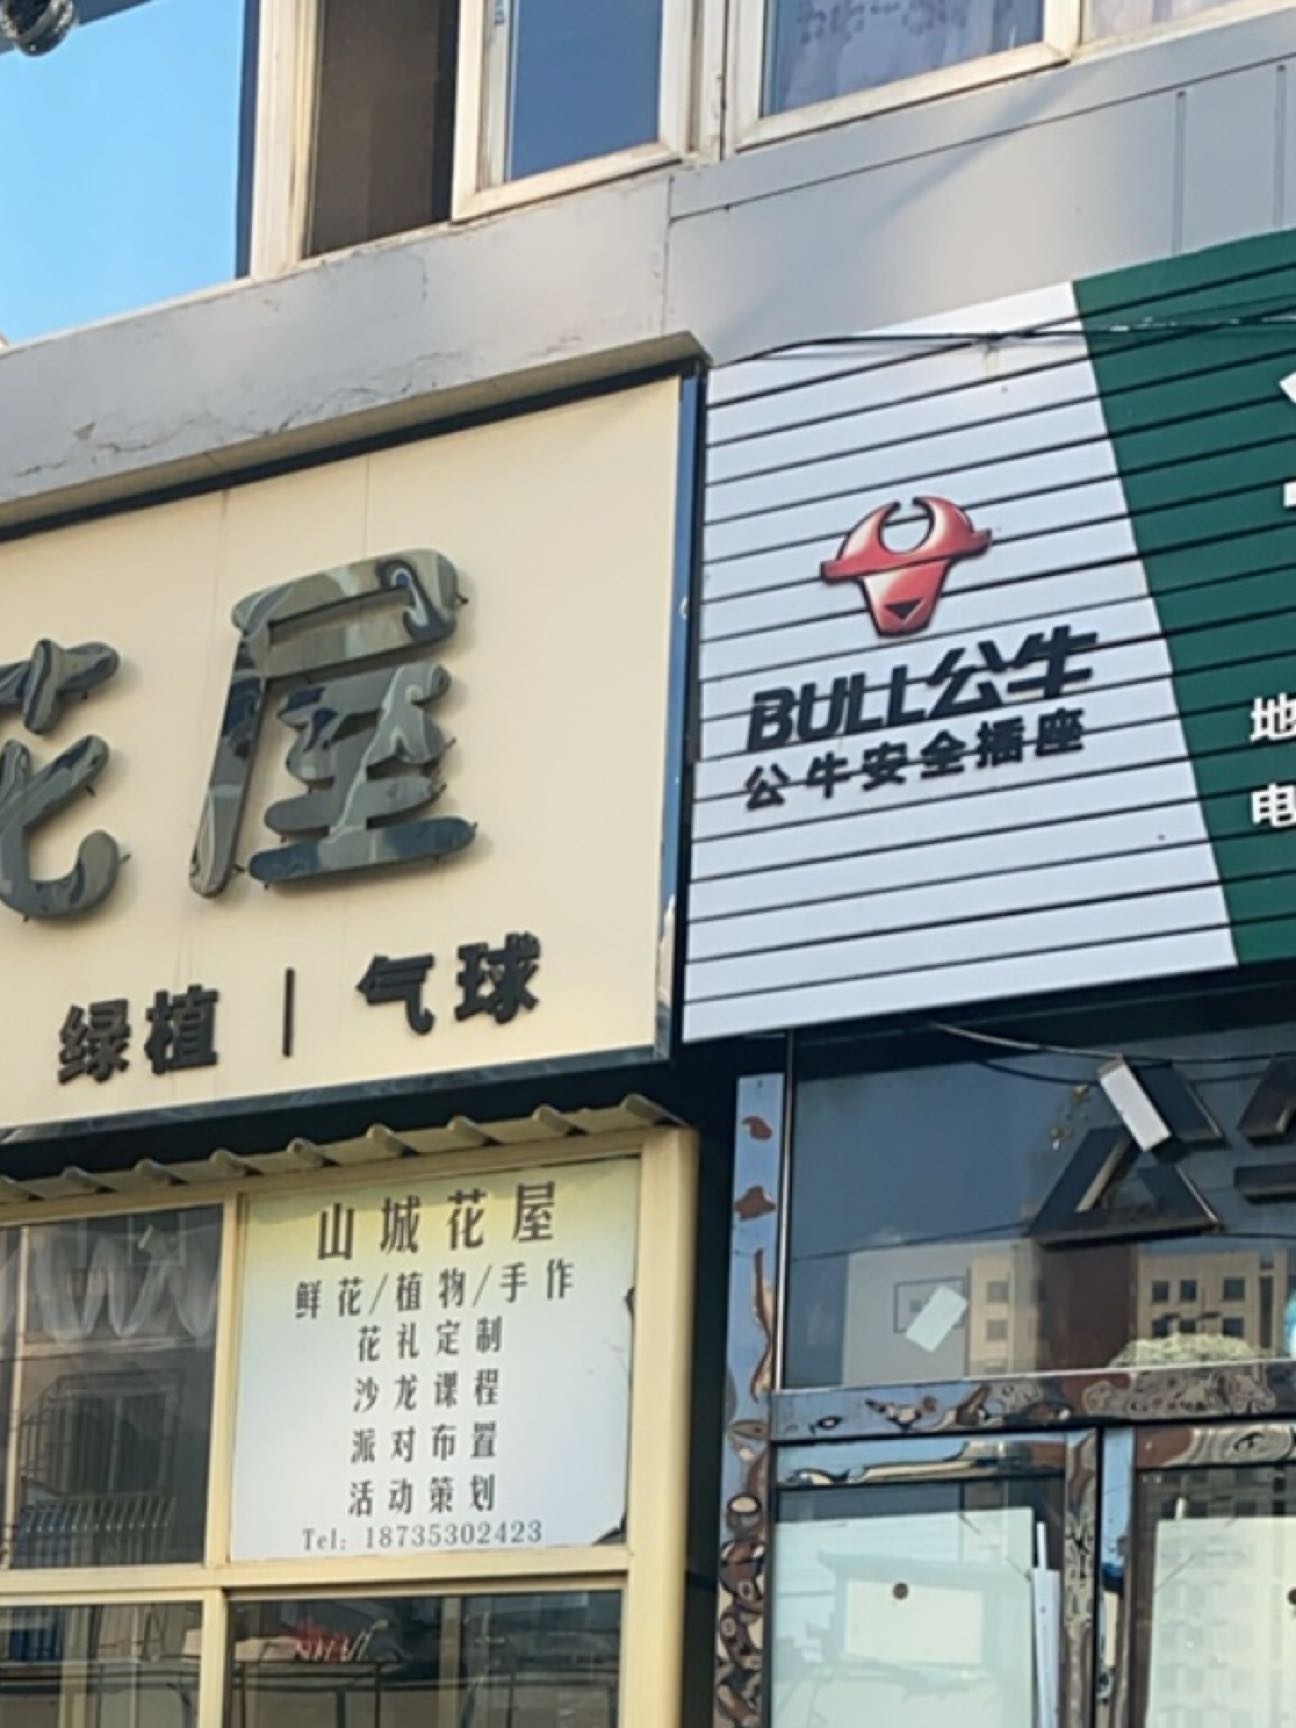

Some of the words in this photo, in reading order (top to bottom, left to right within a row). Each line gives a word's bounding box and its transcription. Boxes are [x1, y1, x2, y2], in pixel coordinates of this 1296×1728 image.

[744, 706, 1086, 812] 公牛安全插座
[58, 985, 219, 1086] 绿植
[356, 933, 541, 1034] 气球
[317, 1180, 556, 1261] 山城花屋
[357, 1316, 503, 1362] 花礼定制
[353, 1369, 500, 1413] 沙龙课程
[350, 1421, 498, 1464] 派对布置
[348, 1474, 497, 1517] 活动策划
